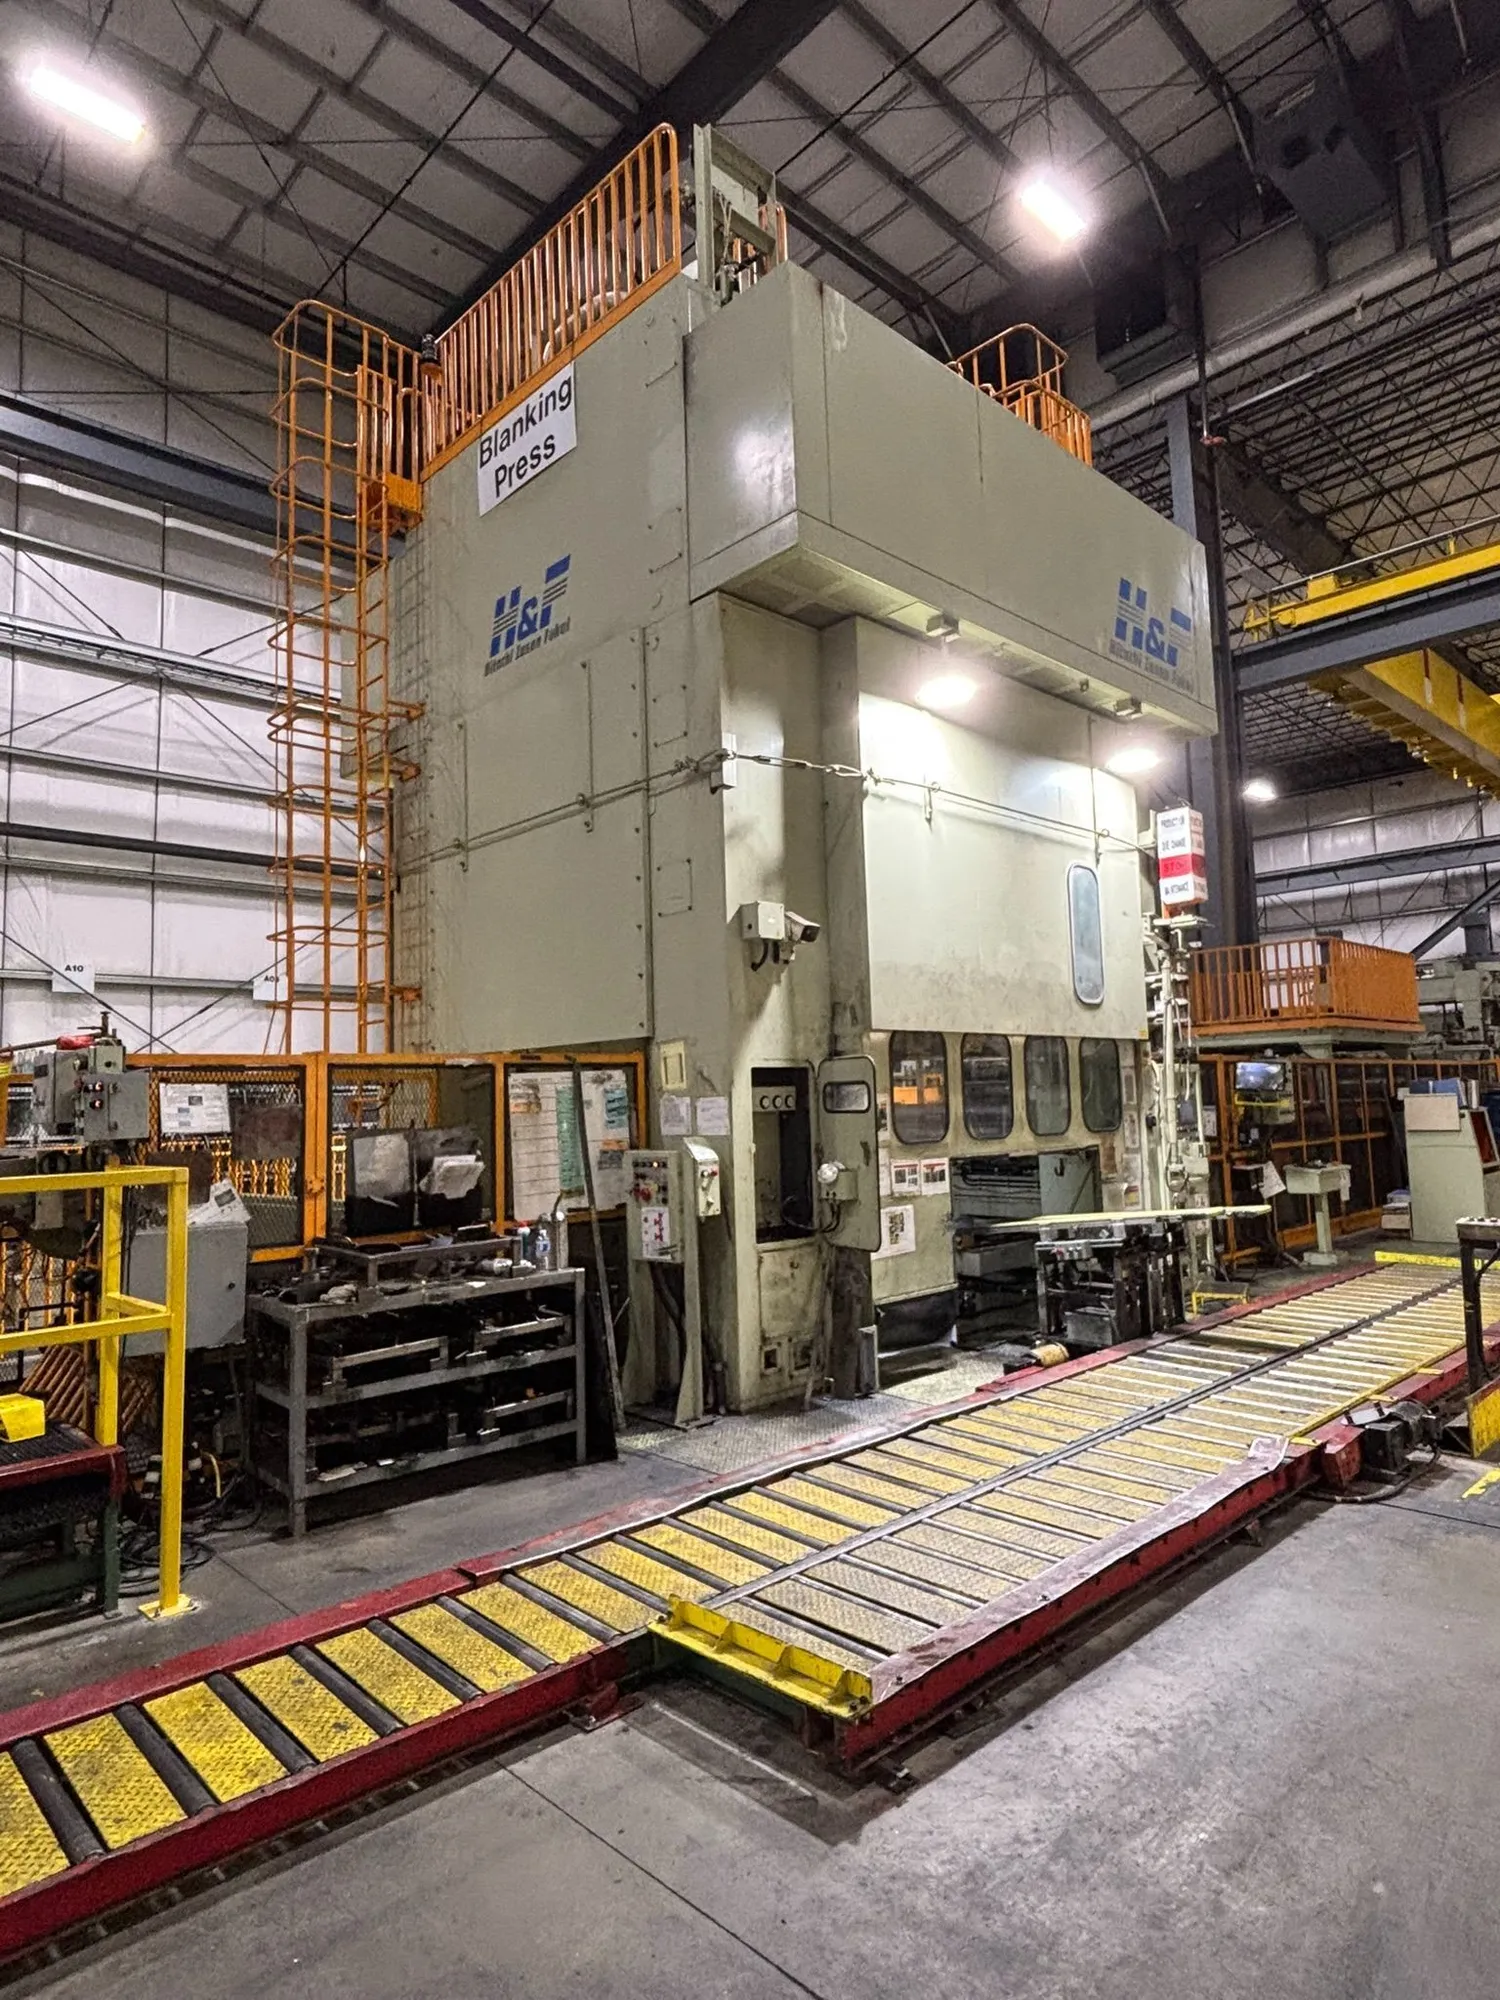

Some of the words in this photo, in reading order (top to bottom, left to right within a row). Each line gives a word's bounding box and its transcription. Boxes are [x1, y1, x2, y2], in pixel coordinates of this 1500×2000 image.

[479, 376, 572, 469] Blanking
[494, 433, 556, 498] Press
[490, 553, 572, 658] H&F
[1114, 577, 1192, 667] H&F
[64, 964, 84, 973] A10
